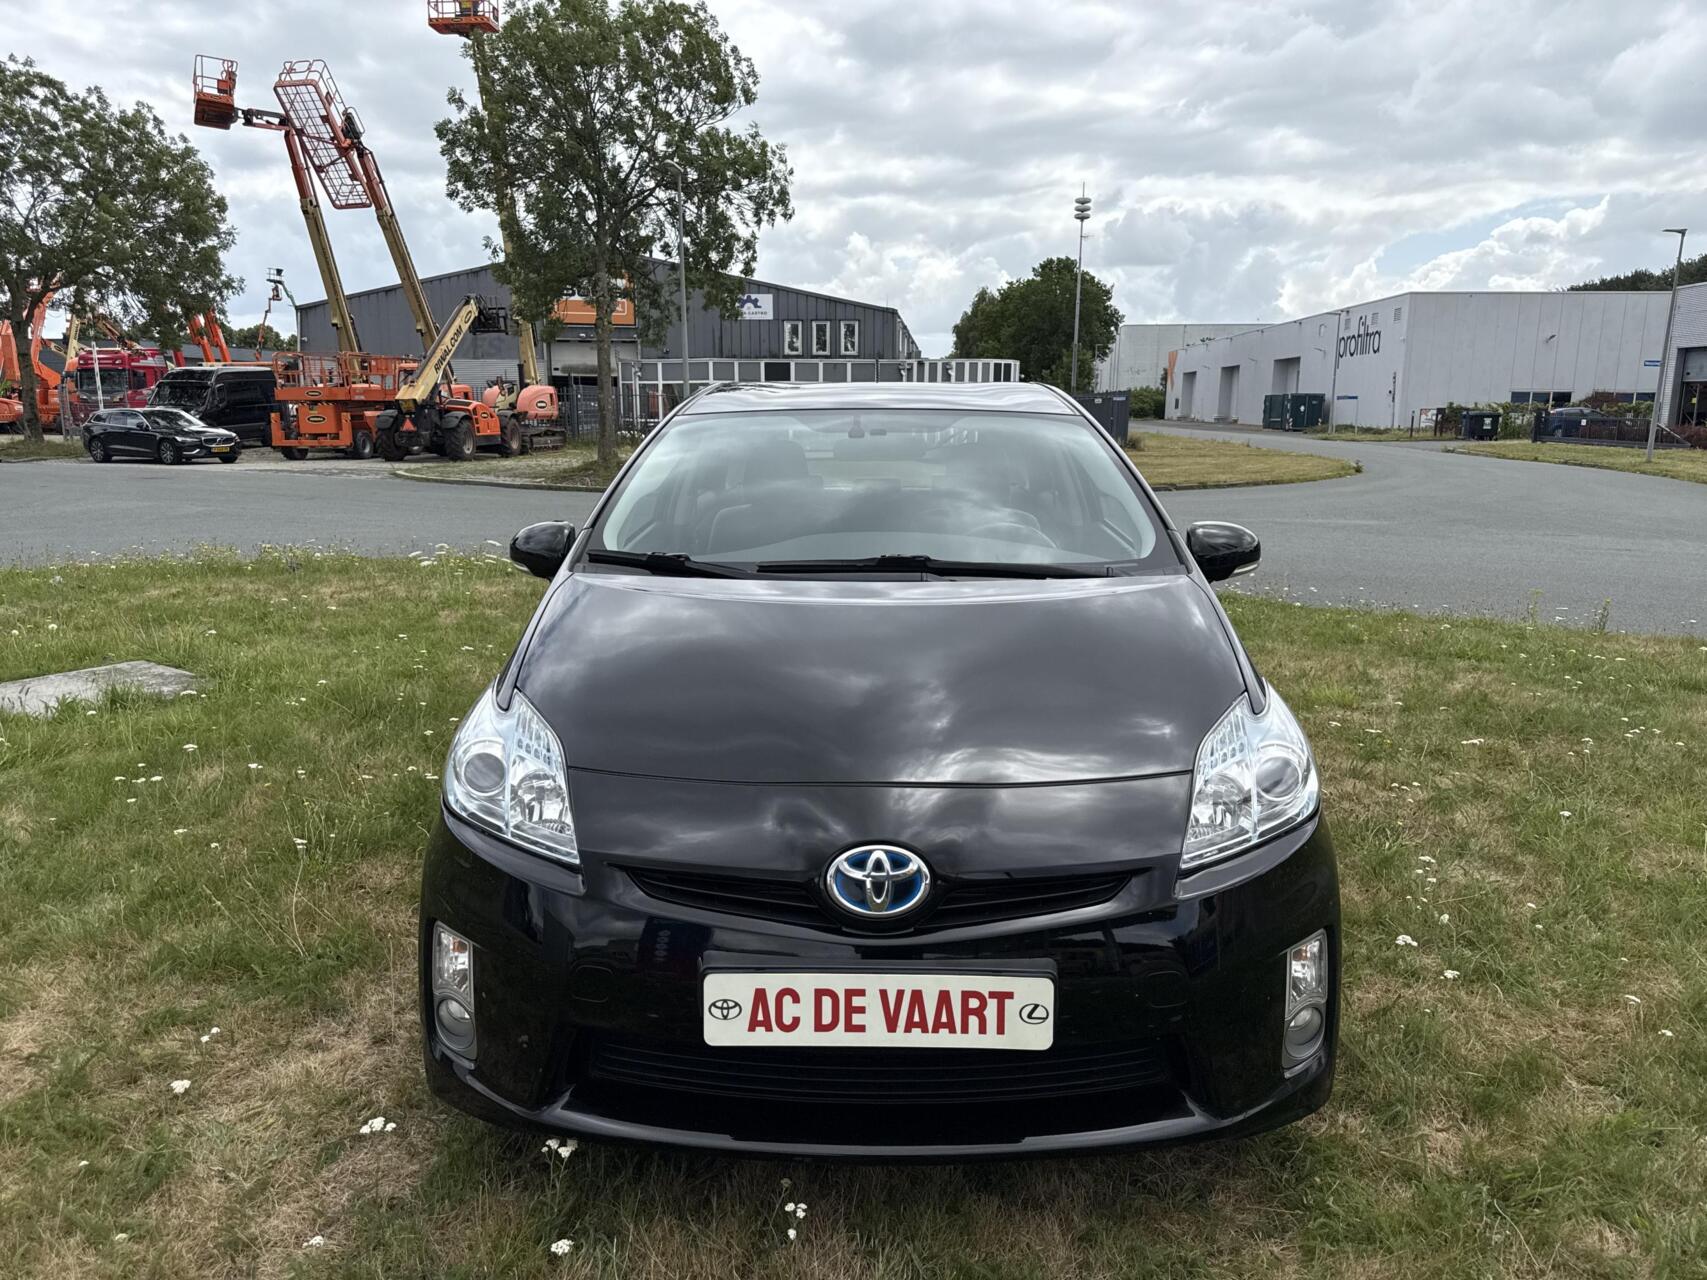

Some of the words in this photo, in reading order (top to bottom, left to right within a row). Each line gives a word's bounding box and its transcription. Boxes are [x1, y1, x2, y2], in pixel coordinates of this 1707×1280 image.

[1337, 315, 1381, 369] profiltra
[747, 987, 801, 1033] AC
[814, 988, 867, 1033] DE
[879, 988, 1015, 1035] VAART
